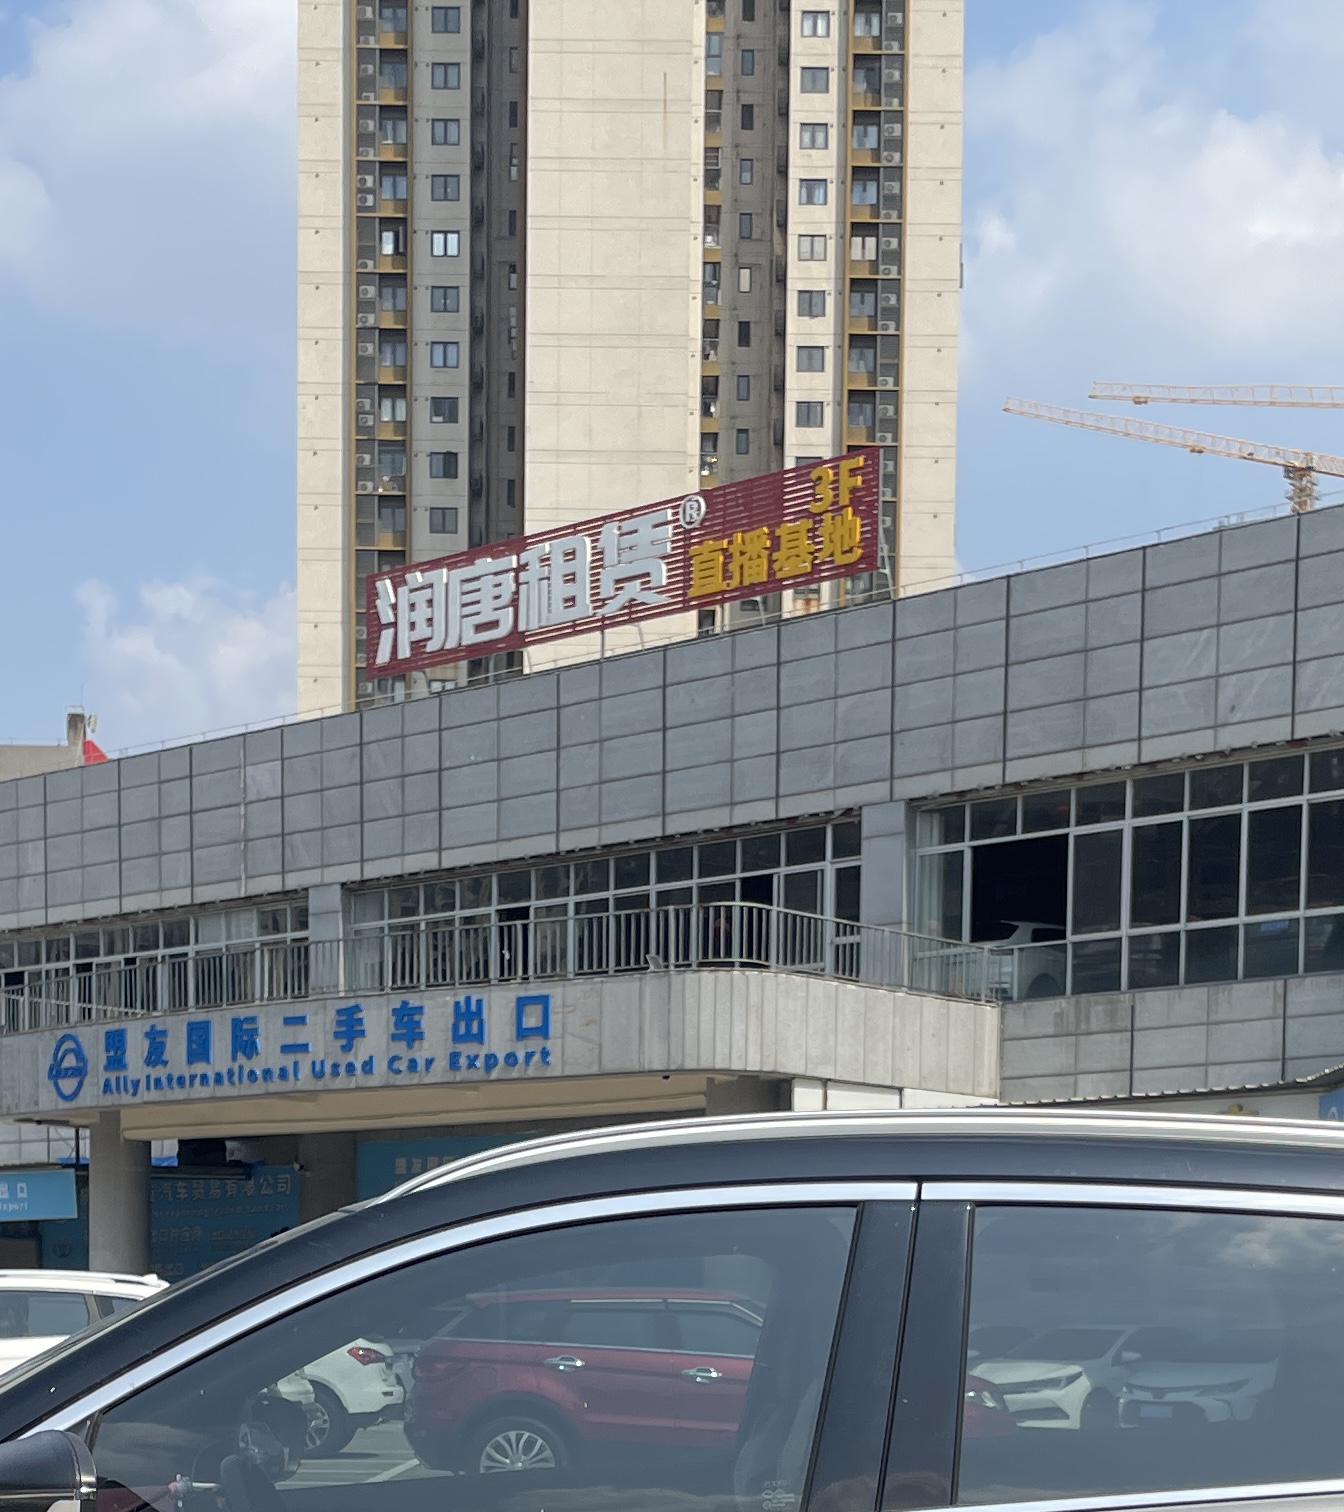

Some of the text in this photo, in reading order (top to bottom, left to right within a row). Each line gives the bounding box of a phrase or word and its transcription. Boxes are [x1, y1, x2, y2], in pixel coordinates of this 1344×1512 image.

[808, 455, 865, 515] 3F
[687, 505, 864, 598] 直播基地
[103, 994, 551, 1072] 盟友国际二手车出口
[145, 1060, 301, 1091] International
[311, 1055, 375, 1079] Used
[387, 1054, 435, 1074] Car
[449, 1046, 551, 1074] Export
